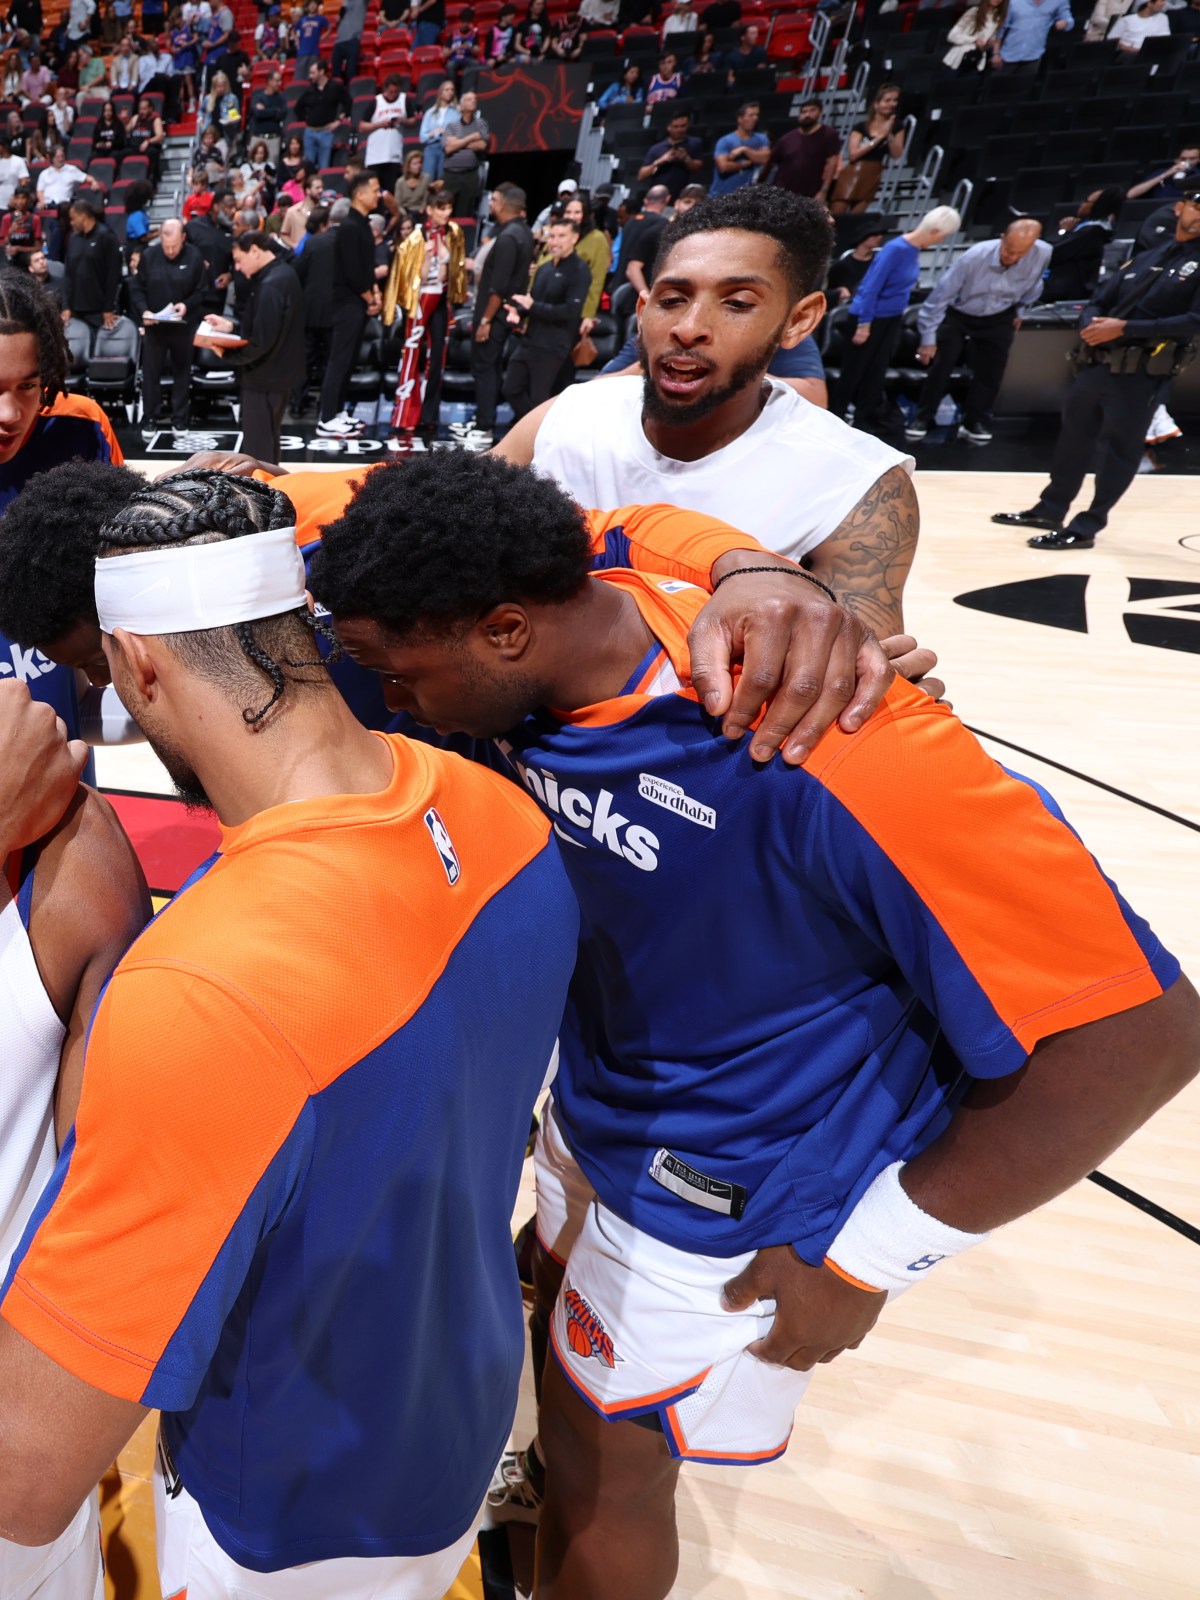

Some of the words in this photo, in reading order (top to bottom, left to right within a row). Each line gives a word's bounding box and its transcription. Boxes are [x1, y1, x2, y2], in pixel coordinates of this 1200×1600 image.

[280, 435, 456, 455] Bapti
[642, 776, 682, 796] experience
[641, 785, 668, 804] abu
[669, 797, 714, 825] dhabi
[565, 1289, 616, 1369] KNICKS
[592, 1311, 606, 1332] YORK
